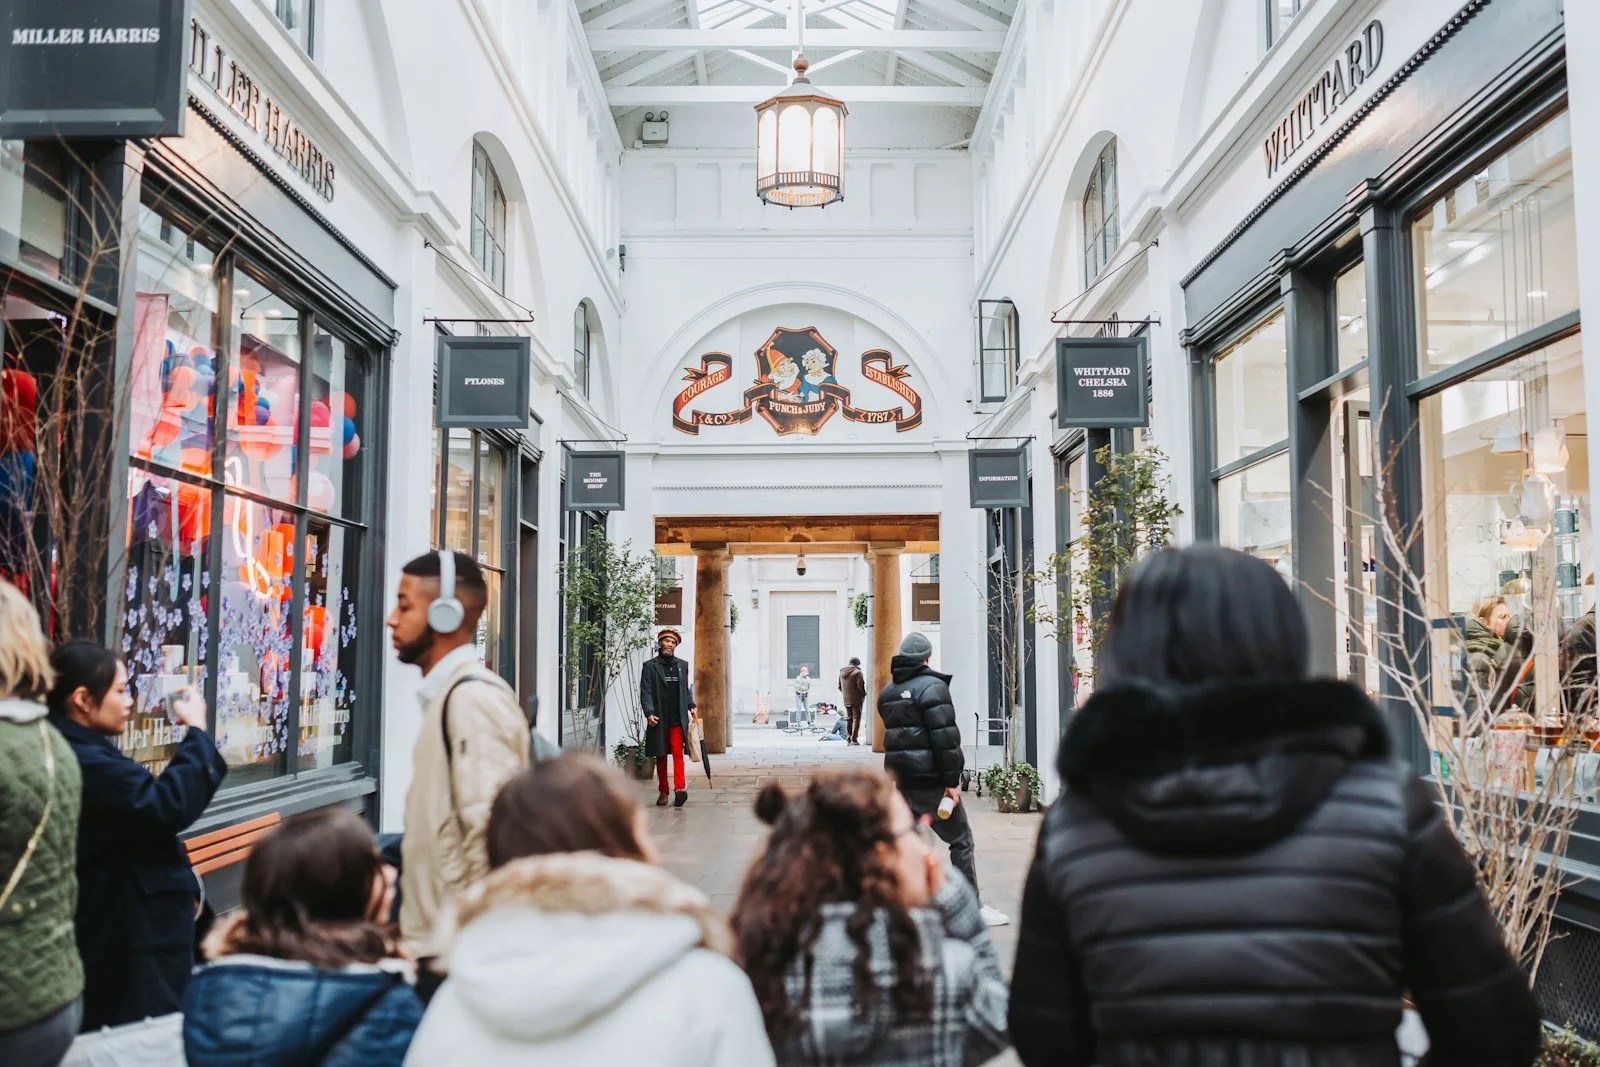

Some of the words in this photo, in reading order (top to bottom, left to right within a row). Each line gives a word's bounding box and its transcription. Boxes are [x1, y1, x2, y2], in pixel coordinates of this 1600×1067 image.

[12, 28, 84, 44] MILLER
[88, 27, 161, 44] HARRIS
[1262, 19, 1384, 179] WHITTARD
[189, 18, 262, 134] ILLER
[265, 97, 336, 203] HARRIS
[1073, 367, 1131, 376] WHITTARD
[464, 377, 505, 386] PYLONES
[682, 370, 725, 403] COURAGE
[865, 364, 917, 405] ESTABLISHED
[1078, 378, 1127, 387] CHELSEA
[1092, 389, 1114, 398] 1886
[866, 411, 889, 423] 1787
